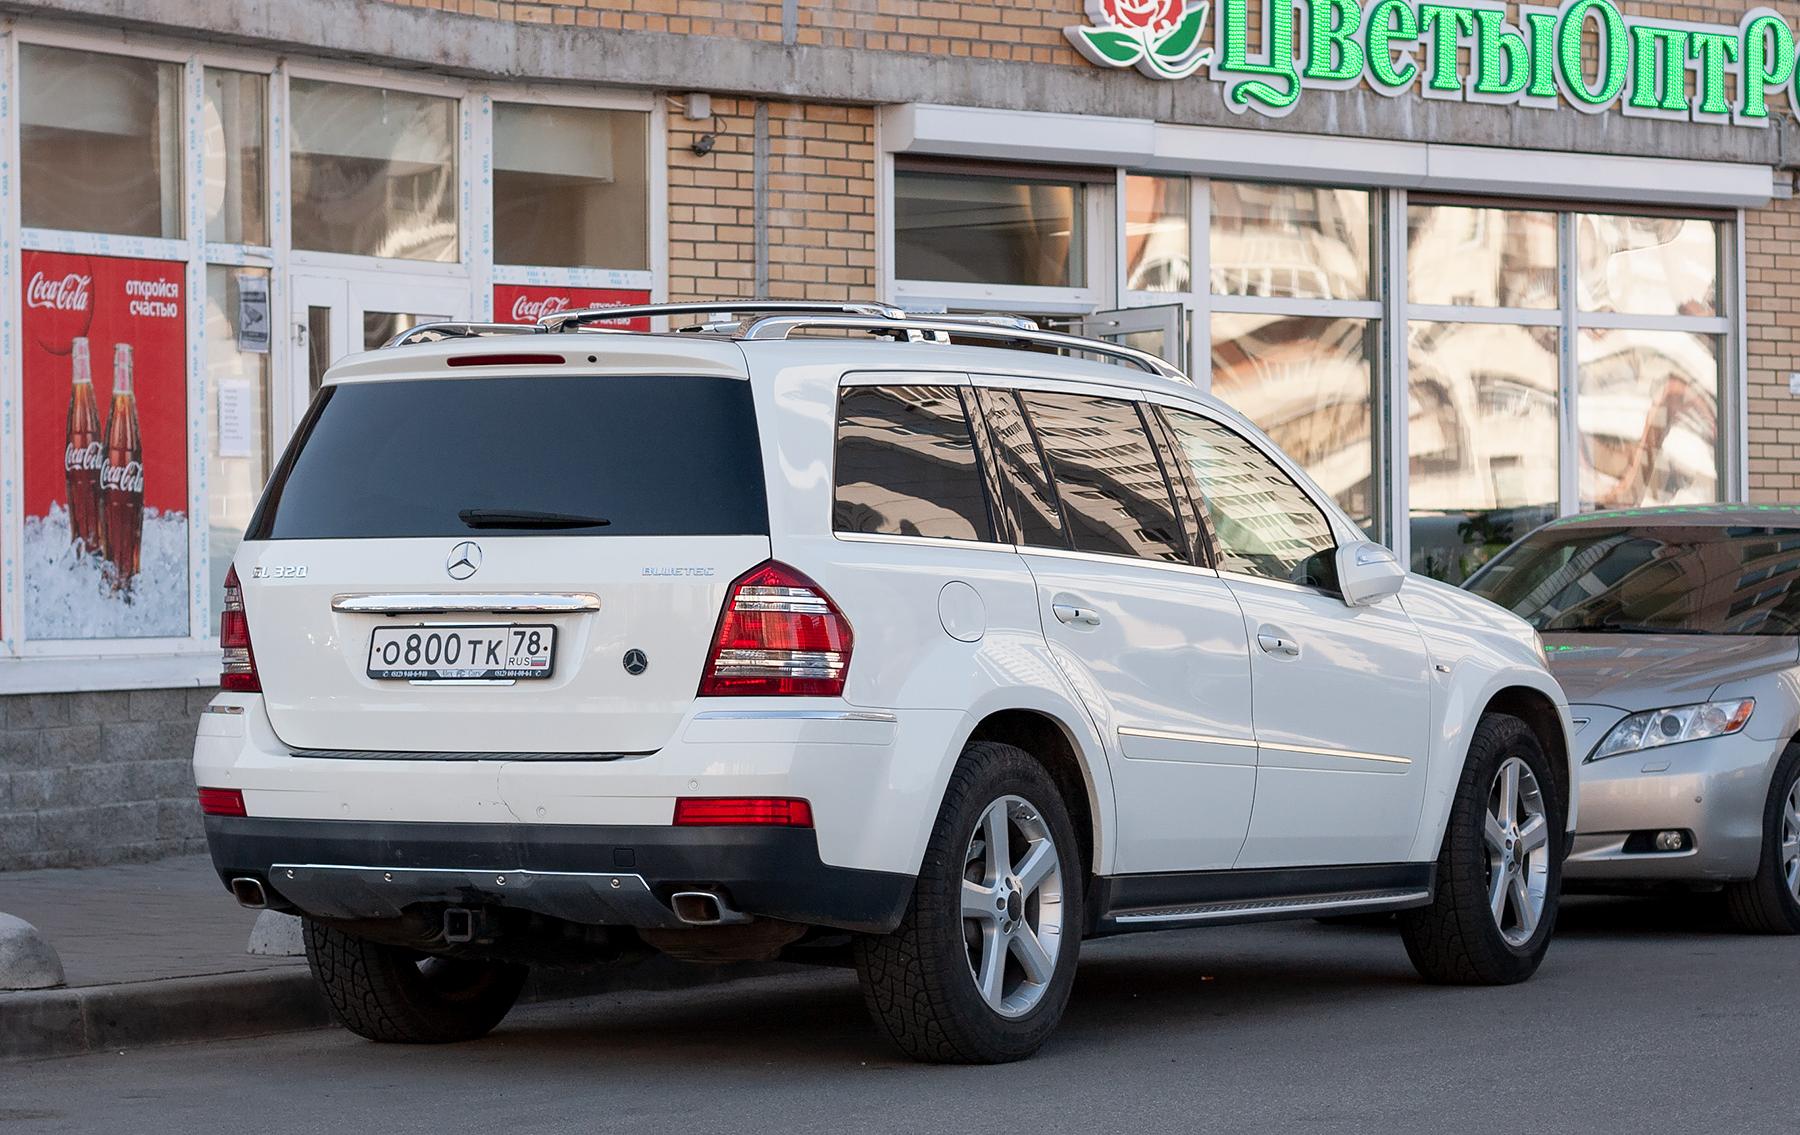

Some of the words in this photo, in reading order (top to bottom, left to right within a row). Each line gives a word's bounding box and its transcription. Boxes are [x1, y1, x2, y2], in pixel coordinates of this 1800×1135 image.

[1217, 0, 1800, 119] ЦветыОптр
[27, 271, 92, 311] Coca-Cola
[126, 277, 178, 300] откройся
[130, 300, 178, 318] счастью
[273, 565, 309, 579] 320
[641, 567, 715, 577] BLUETEC
[513, 631, 541, 656] 78
[508, 657, 530, 666] RUS
